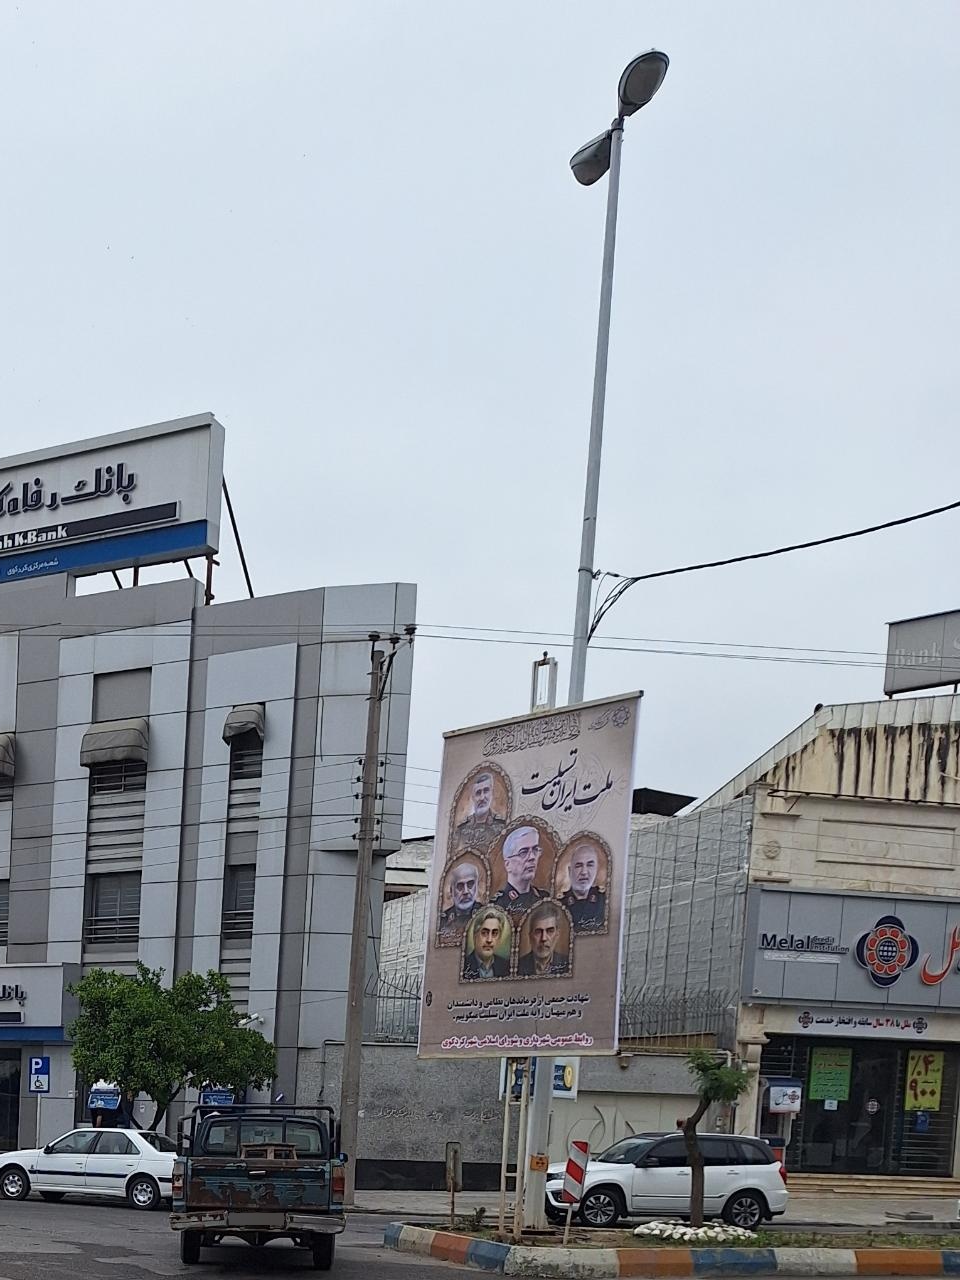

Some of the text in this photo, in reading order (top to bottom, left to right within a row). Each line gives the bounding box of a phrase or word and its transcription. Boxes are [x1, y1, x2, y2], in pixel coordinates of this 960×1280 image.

[7, 477, 58, 515] رفاه
[15, 525, 68, 547] K.Bank
[522, 748, 613, 812] ملت ایران تسلیت
[761, 933, 810, 949] Melal
[447, 998, 478, 1010] دانشمندان
[484, 997, 503, 1009] نظامی
[544, 995, 566, 1006] جمعی
[567, 993, 590, 1003] شهادت
[499, 1009, 515, 1021] ایران
[516, 1009, 529, 1018] ملت
[442, 1037, 467, 1048] کردکوی
[478, 1035, 498, 1047] اسلامی
[499, 1036, 519, 1047] شورای
[524, 1034, 551, 1046] شهرداری
[551, 1036, 573, 1046] عمومی
[574, 1033, 593, 1045] روابط
[31, 1058, 43, 1075] P
